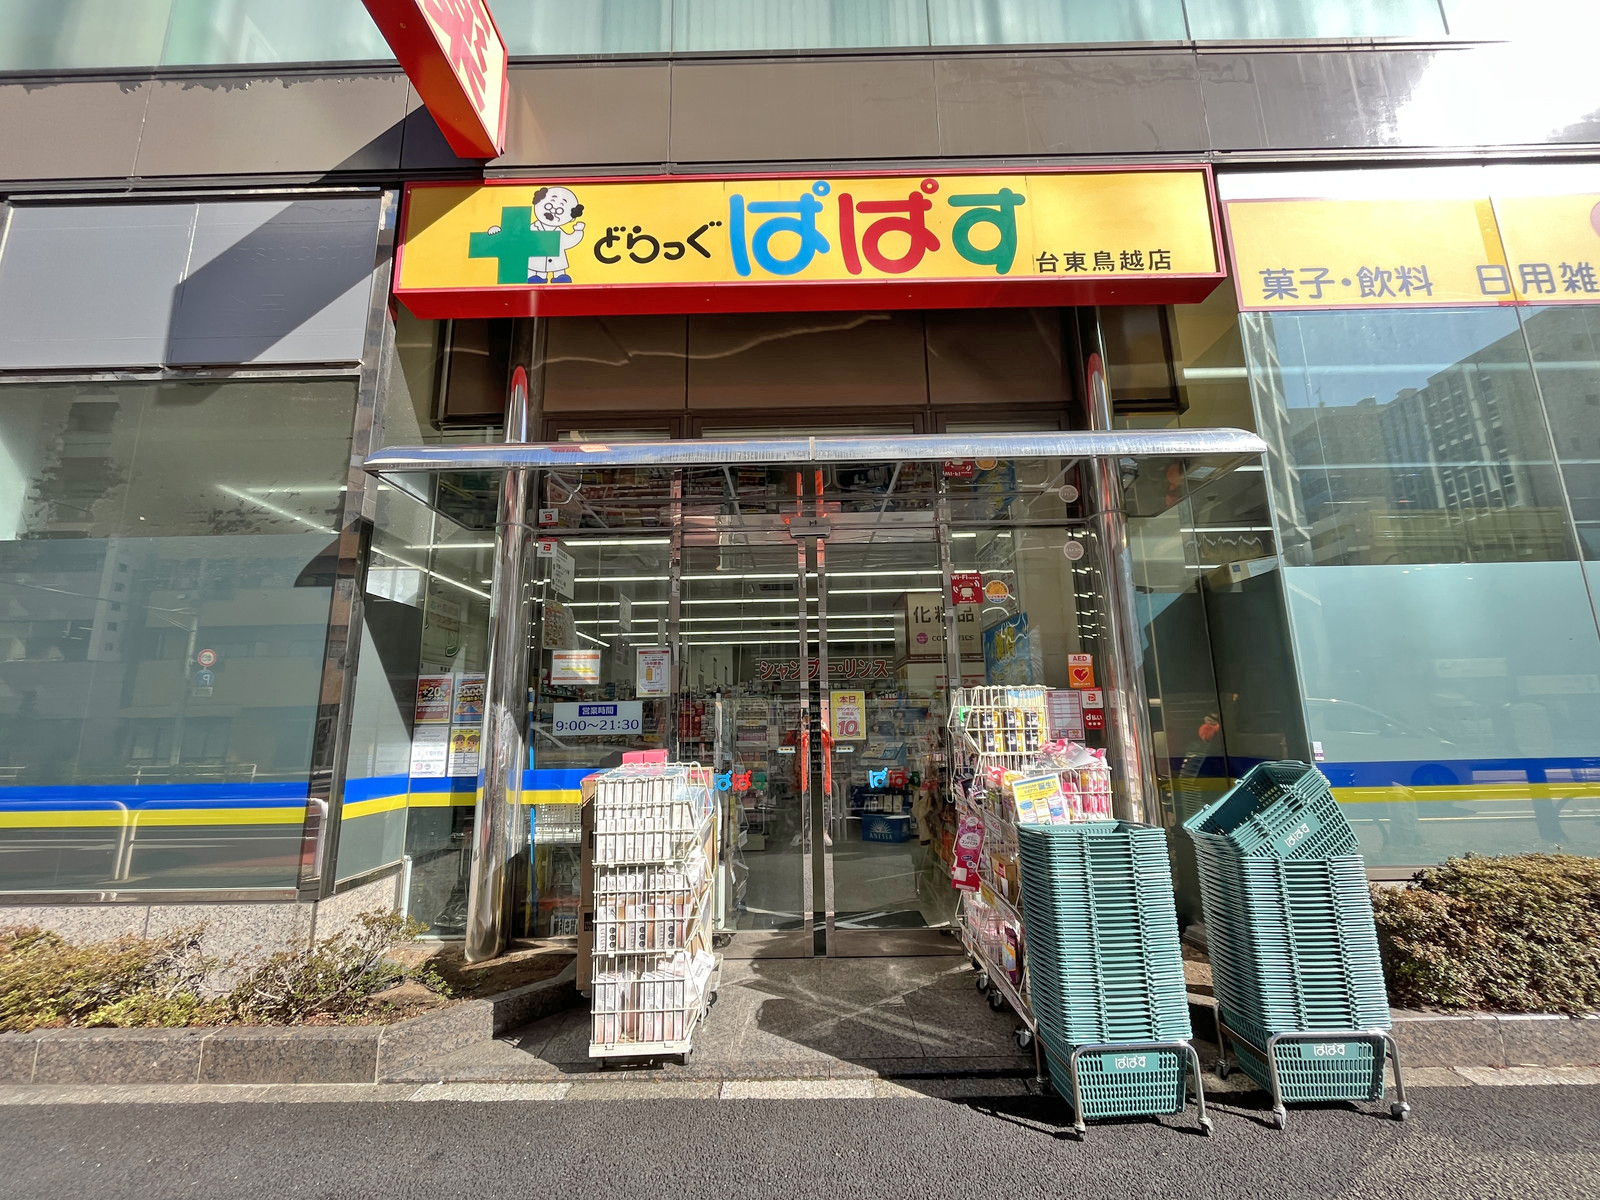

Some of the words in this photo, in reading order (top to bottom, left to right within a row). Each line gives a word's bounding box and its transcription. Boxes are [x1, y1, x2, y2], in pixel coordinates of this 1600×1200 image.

[594, 220, 723, 265] どらっぐ
[729, 178, 1026, 277] ぱぱす
[1036, 249, 1172, 274] 台東鳥越店
[1258, 264, 1434, 300] 菓子・飲料
[1475, 261, 1600, 296] 日用雑
[582, 706, 614, 716] 営業時間
